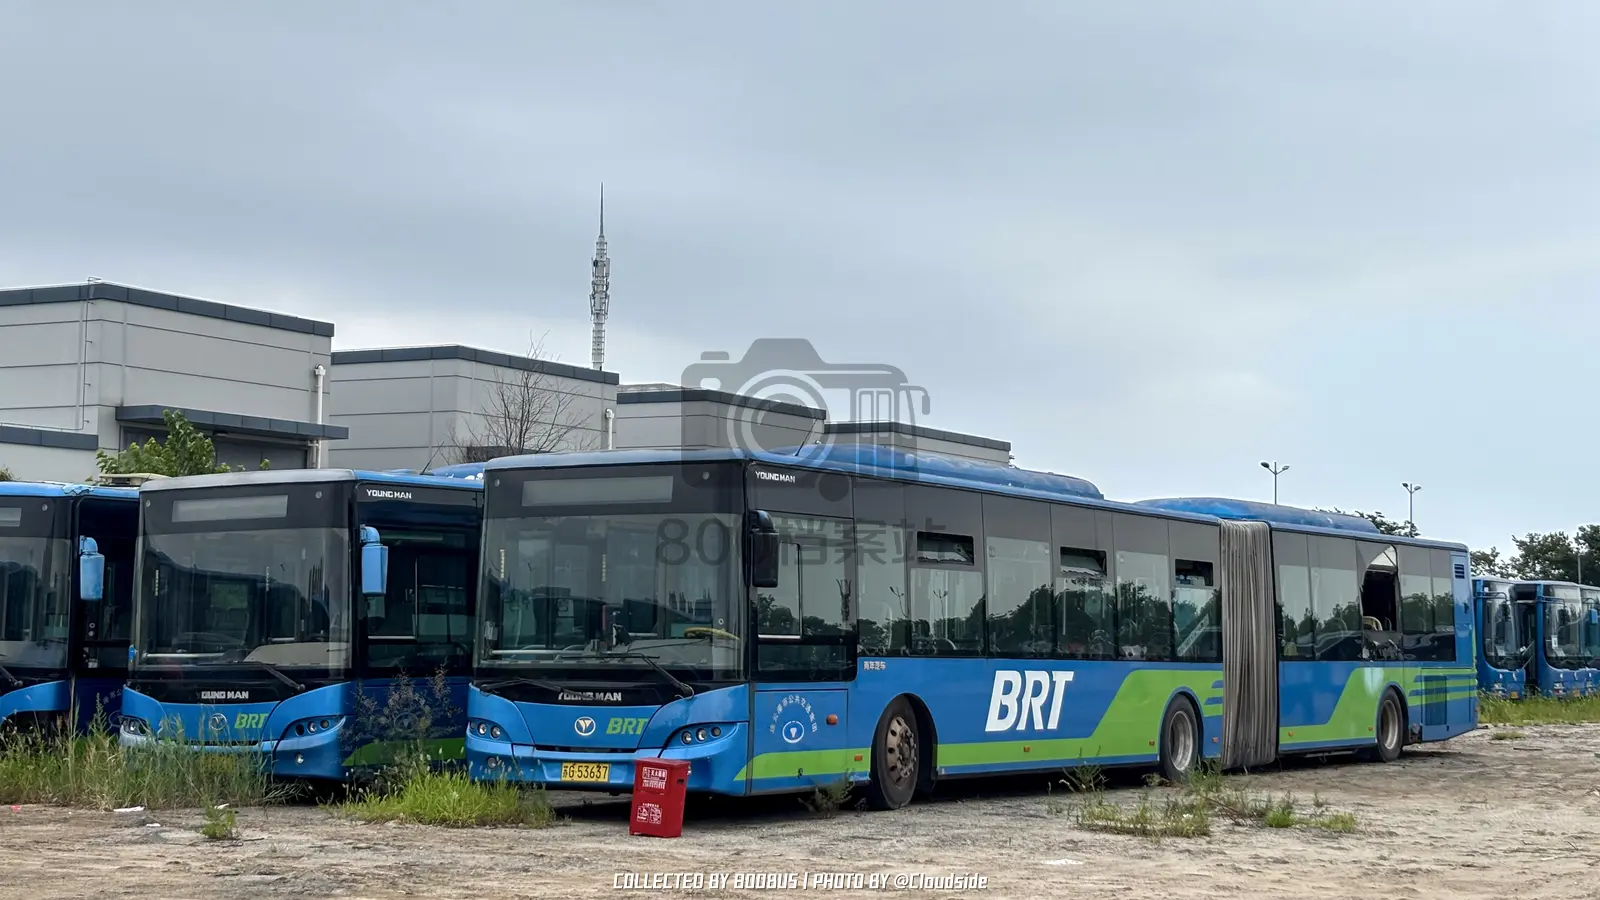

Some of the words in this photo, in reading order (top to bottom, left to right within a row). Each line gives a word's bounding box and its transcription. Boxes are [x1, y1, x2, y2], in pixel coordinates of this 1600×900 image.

[985, 670, 1074, 732] BRT
[234, 712, 270, 729] BRT
[605, 717, 648, 735] BRT
